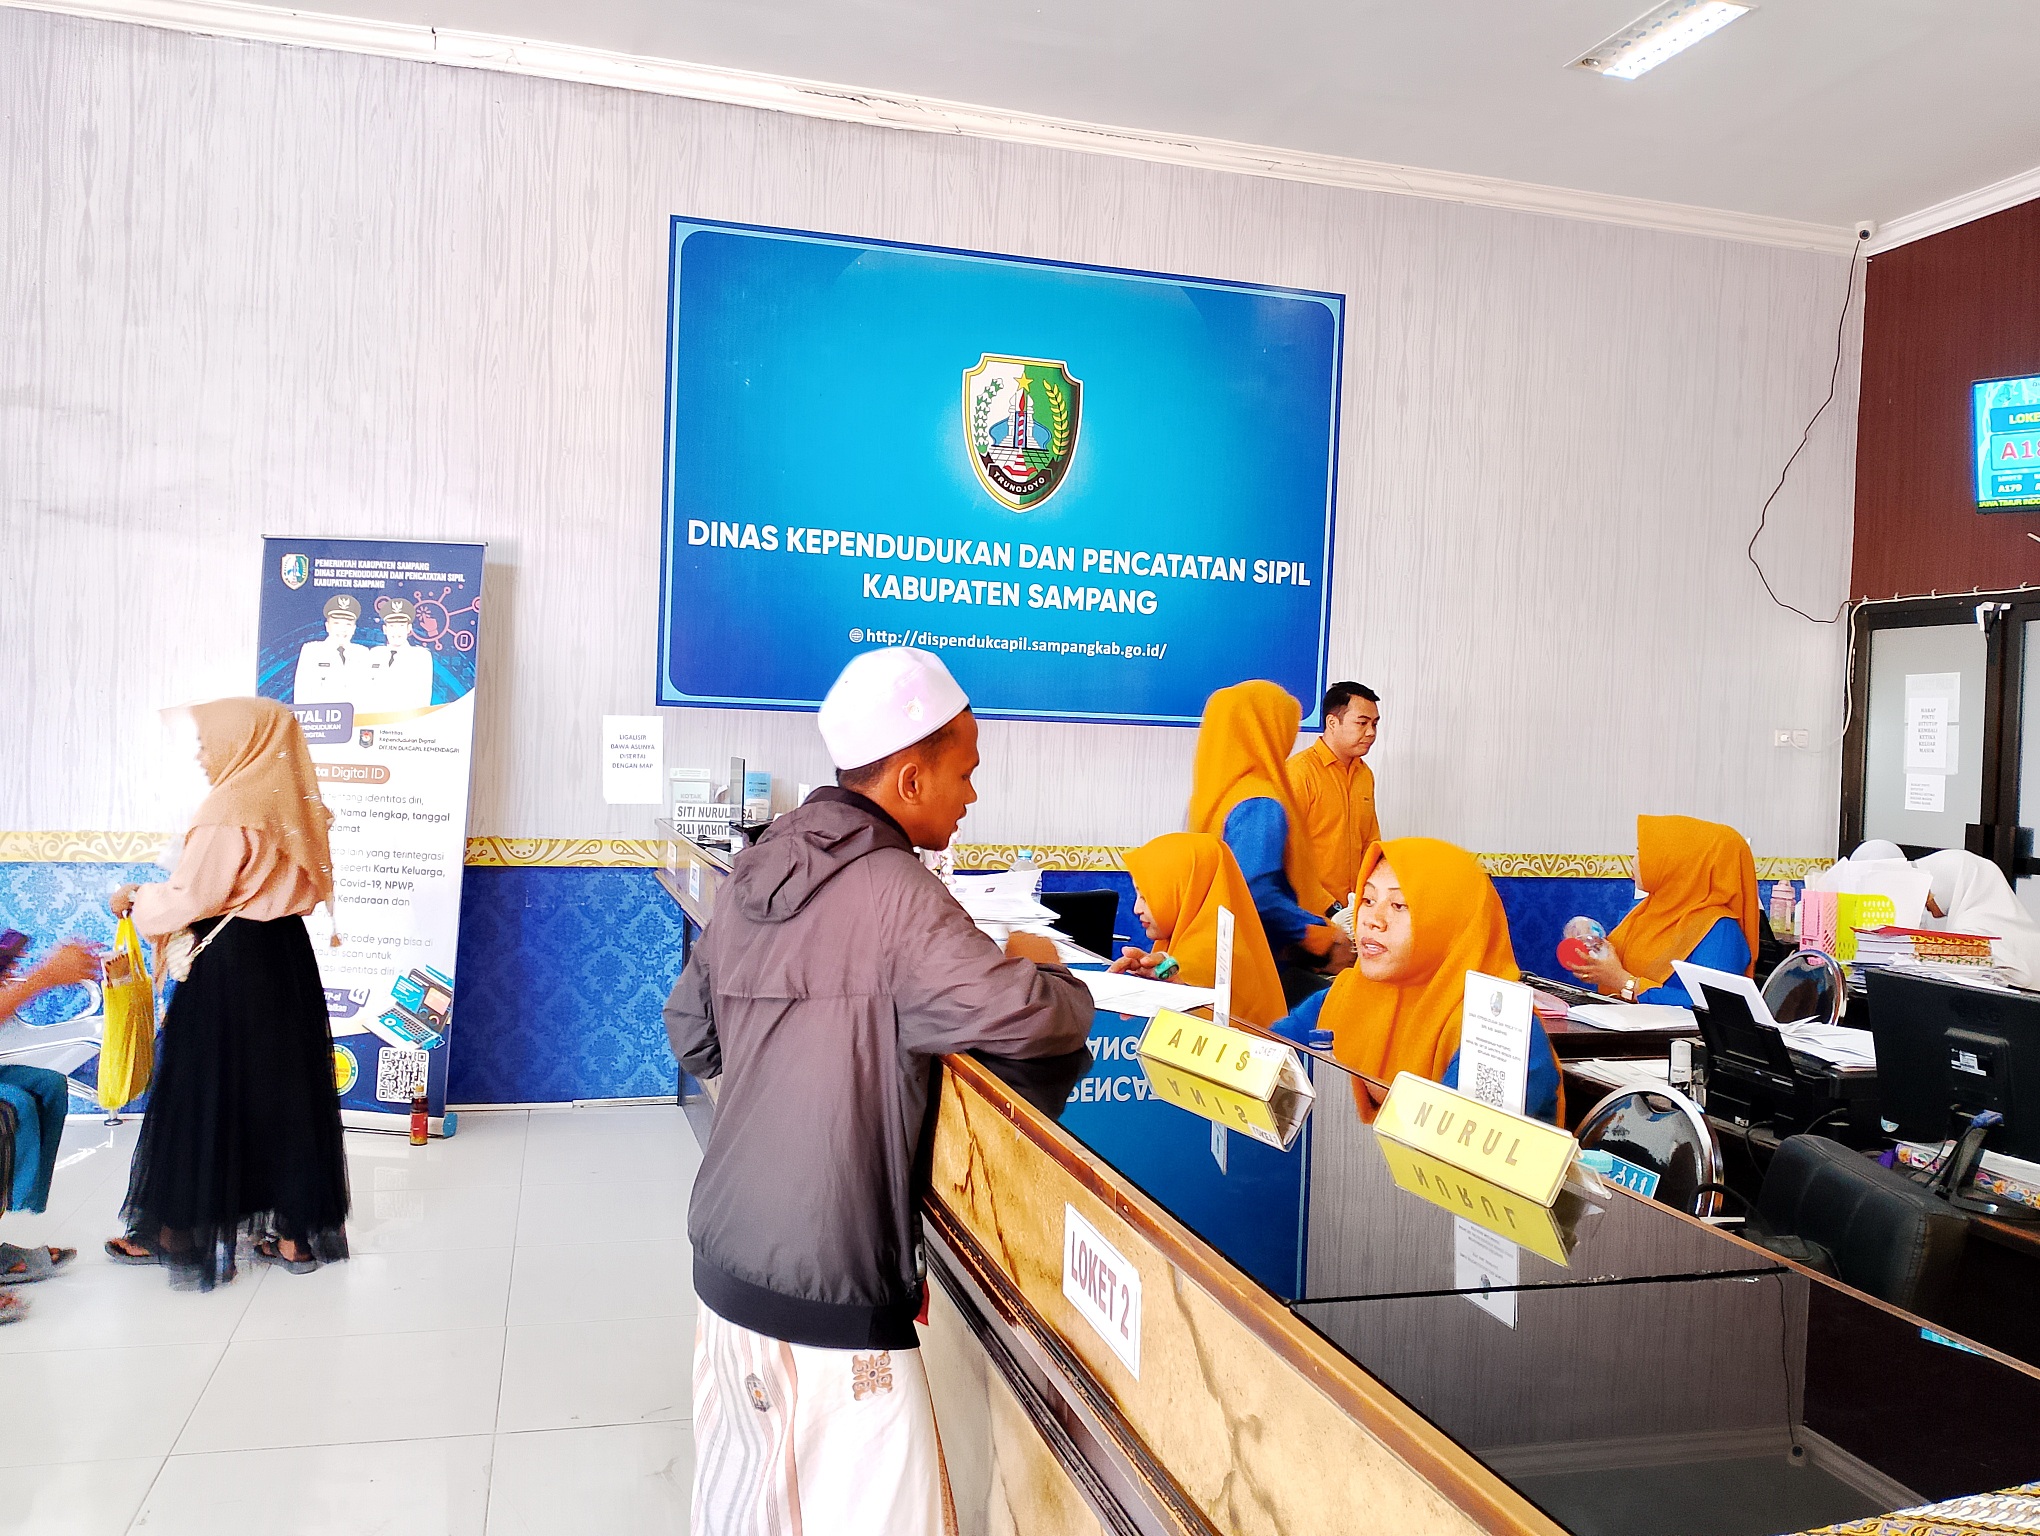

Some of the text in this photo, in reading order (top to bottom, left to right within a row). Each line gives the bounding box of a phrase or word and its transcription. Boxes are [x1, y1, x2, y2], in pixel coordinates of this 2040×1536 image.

[2008, 412, 2040, 425] LOKE
[993, 471, 1045, 493] TRUNOJOYO
[687, 519, 1311, 586] DINAS KEPENDUDUKAN DAN PENCATATAN SIPIL
[315, 559, 430, 571] PEMERINTAH KABUPATEN SAMPANG
[314, 569, 466, 583] DINAS KEPENDUDUKAN DAN PENCATATAN SIPIL
[314, 578, 385, 589] KABUPATEN SAMPANG
[862, 573, 1158, 615] KABUPATEN SAMPANG
[866, 628, 1168, 660] http://dispendukcapil.sampangkab.go.id/
[294, 709, 342, 723] ITAL ID
[302, 723, 342, 731] PENDUDUKAN
[314, 766, 385, 780] ta Digital ID
[365, 793, 407, 804] identitas
[340, 808, 367, 818] Nama
[369, 809, 410, 822] lengkap,
[412, 812, 450, 824] tanggal
[677, 806, 695, 818] SITI
[366, 850, 390, 860] yang
[393, 850, 445, 862] terintegrasi
[373, 864, 400, 874] Kartu
[401, 866, 446, 878] Keluarga,
[339, 878, 382, 890] Covid-19,
[384, 880, 415, 892] NPWP,
[337, 894, 410, 907] Kendaraan dan
[351, 934, 375, 944] code
[377, 936, 401, 947] yang
[403, 936, 422, 947] bisa
[342, 950, 363, 958] scan
[366, 951, 392, 960] untuk
[1167, 1028, 1250, 1072] ANIS
[1413, 1101, 1521, 1166] NURUL
[1071, 1230, 1130, 1341] LOKET 2
